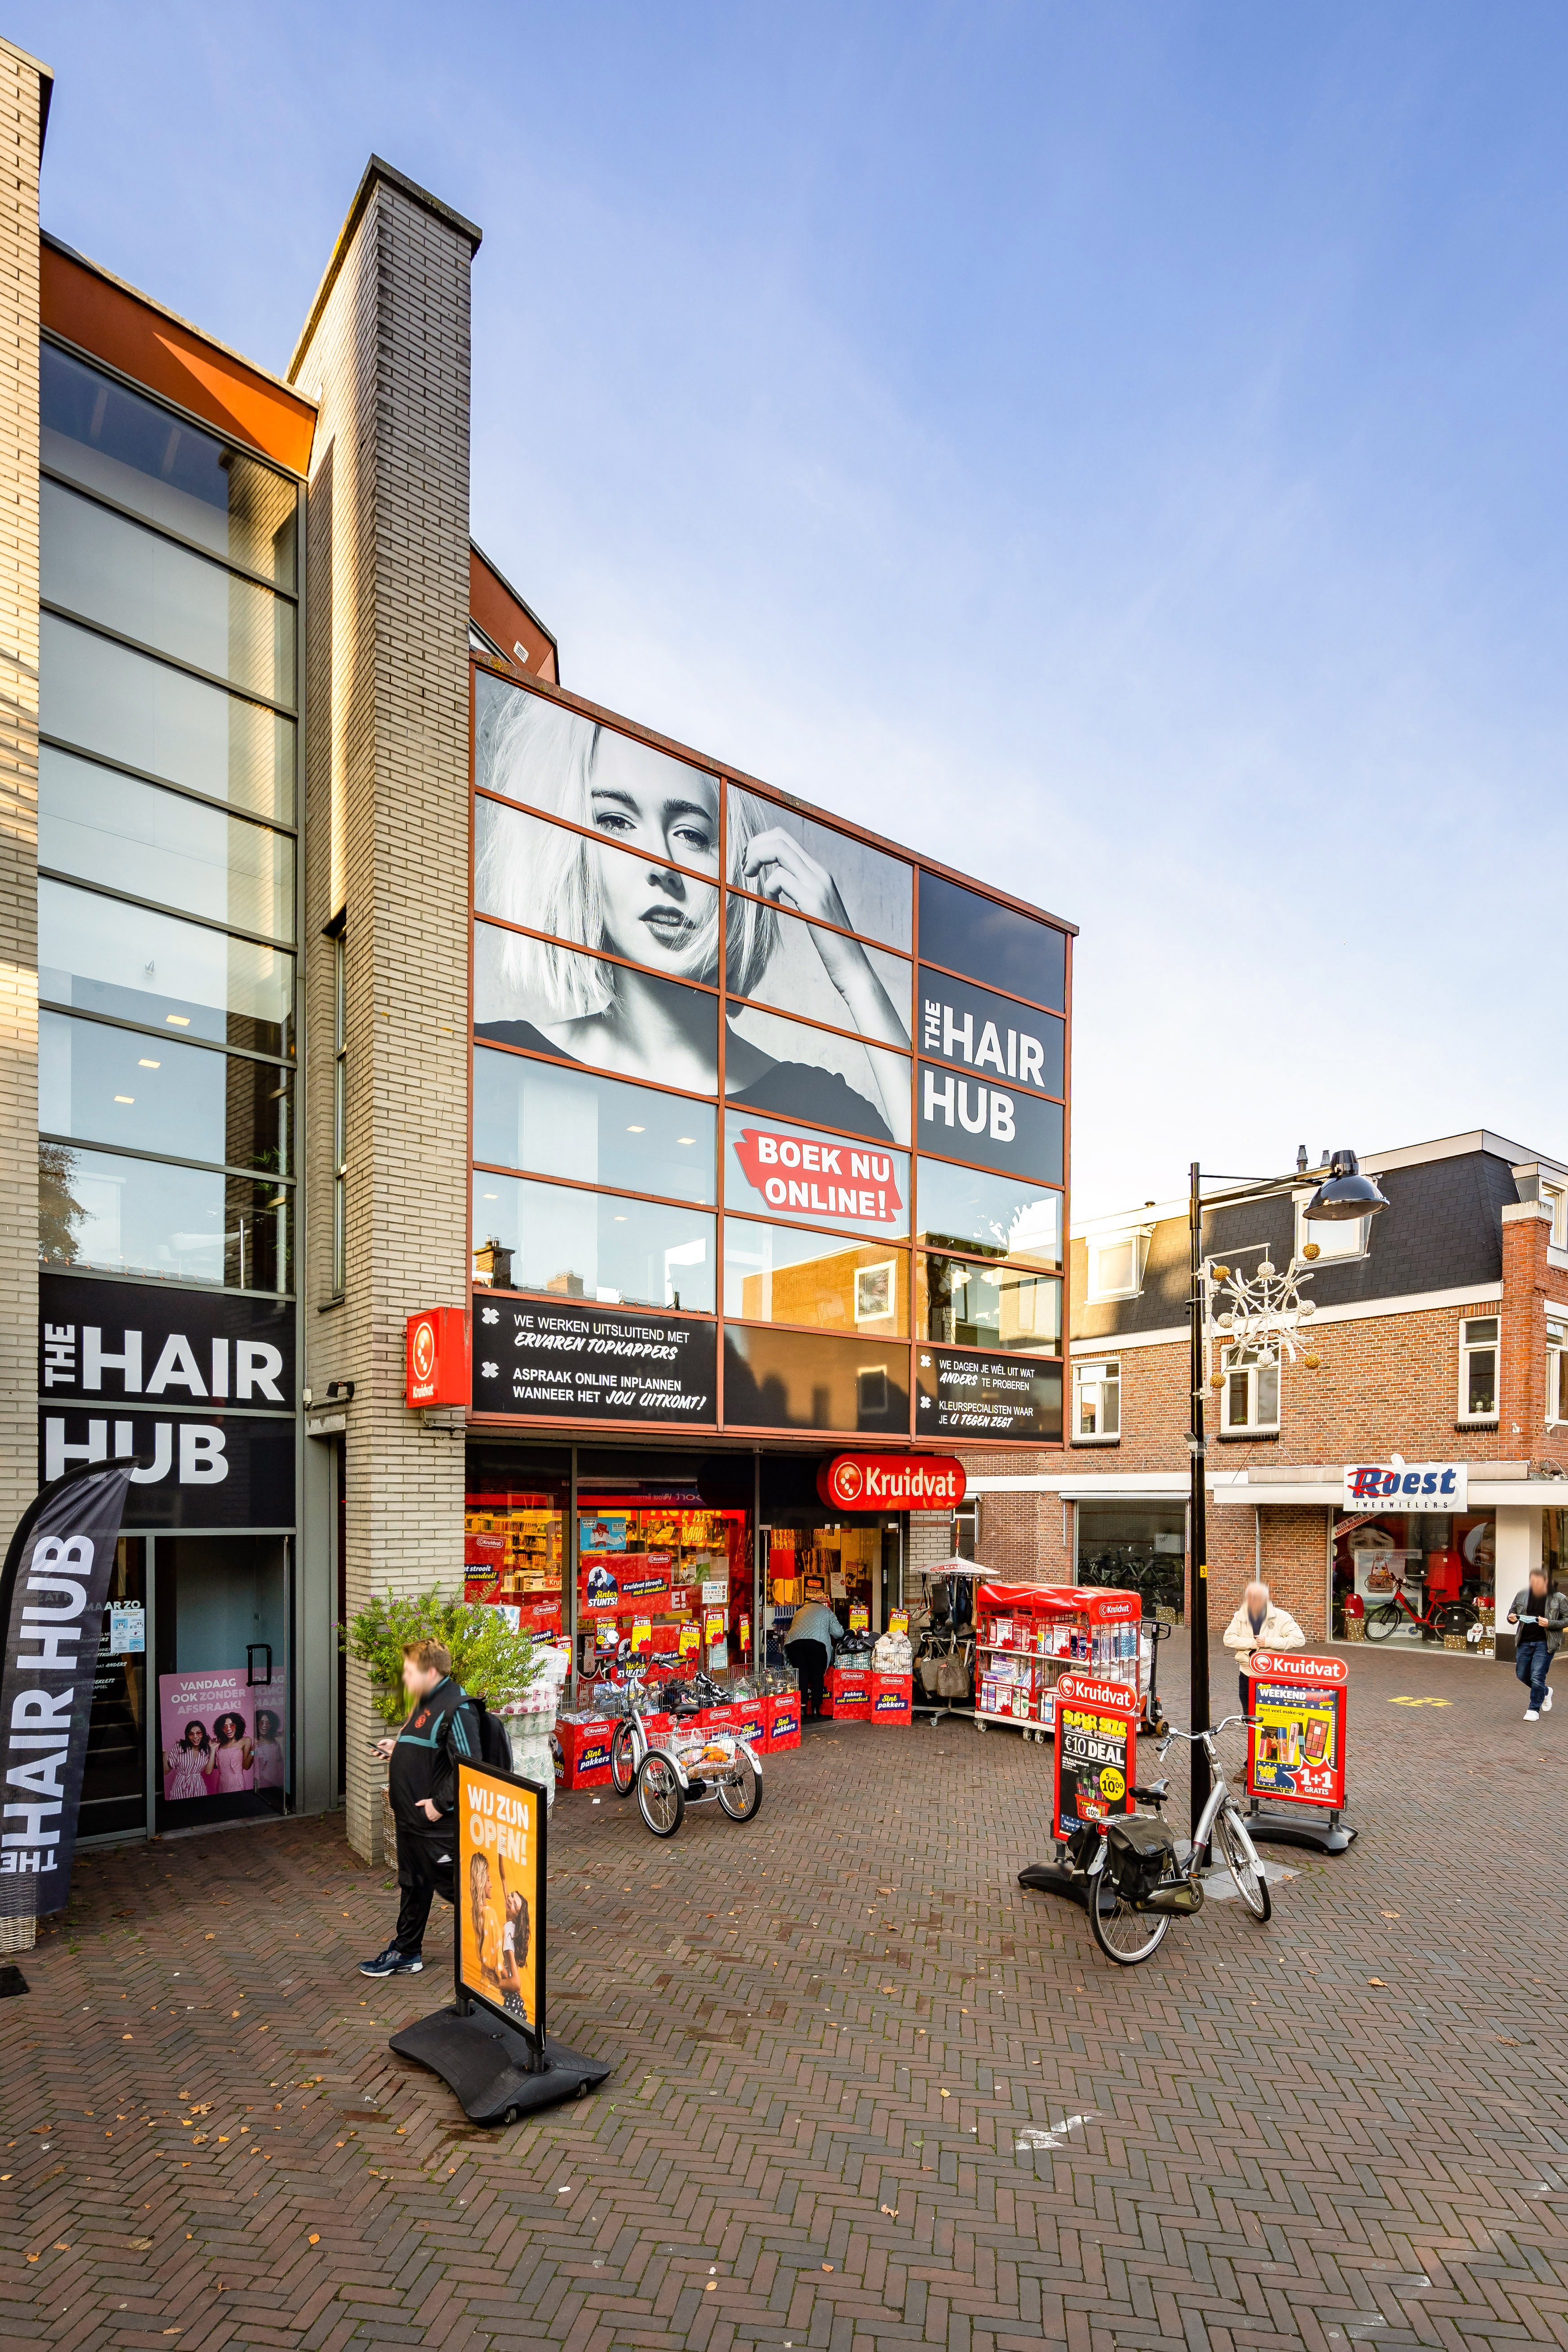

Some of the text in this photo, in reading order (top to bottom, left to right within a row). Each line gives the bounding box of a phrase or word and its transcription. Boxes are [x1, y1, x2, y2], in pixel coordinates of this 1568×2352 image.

[925, 999, 1045, 1088] THE HAIR
[923, 1069, 1016, 1142] HUB
[757, 1136, 890, 1182] BOEK NU
[764, 1177, 887, 1218] ONLINE!
[514, 1314, 690, 1344] WE WERKEN UITSLUITEND MET
[514, 1332, 678, 1360] ERVAREN TOPKAPPERS
[44, 1323, 285, 1401] THE HAIR
[939, 1359, 1035, 1378] WE DAGEN JE WÉL UIT WAT
[513, 1367, 681, 1391] ASPRAAK ONLINE INPLANNEN
[939, 1372, 1029, 1391] ANDERS TE PROBEREN
[413, 1383, 434, 1398] Kruidvat
[513, 1386, 707, 1411] WANNEER HET JOU UITKOMT!
[939, 1400, 1033, 1416] KLEURSPECIALISTEN WAAR
[939, 1413, 1014, 1428] JE U TEGEN ZEGT
[46, 1417, 228, 1484] HUB
[866, 1466, 956, 1497] Kruidvat
[1347, 1467, 1457, 1499] Roest
[595, 1590, 618, 1599] Sinter
[623, 1579, 663, 1591] Kruidvat strooit
[644, 1584, 667, 1594] voordeel!
[123, 1600, 141, 1609] ZO
[588, 1597, 618, 1607] STUNTS!
[1107, 1604, 1129, 1613] Kruidvat
[532, 1631, 551, 1641] strooit
[557, 1641, 571, 1649] ACTIE!
[1274, 1657, 1340, 1677] Kruidvat
[180, 1678, 236, 1691] VANDAAG
[1076, 1681, 1130, 1706] Kruidvat
[0, 1535, 95, 1873] HUB HAIR THE
[171, 1688, 246, 1703] OOK ZONDER
[177, 1700, 242, 1715] AFSPRAAK!
[773, 1723, 796, 1737] pakkers
[777, 1717, 789, 1727] Sint
[1063, 1709, 1127, 1737] SUPER SIZE
[585, 1748, 602, 1759] Sint
[1064, 1735, 1125, 1765] €10 DEAL
[580, 1755, 610, 1771] pakkers
[1299, 1768, 1333, 1789] 1+1
[1304, 1786, 1329, 1795] GRATIS
[467, 1784, 529, 1830] WIJ ZIJN
[1064, 1819, 1075, 1828] Bespaar
[470, 1814, 527, 1866] OPEN!
